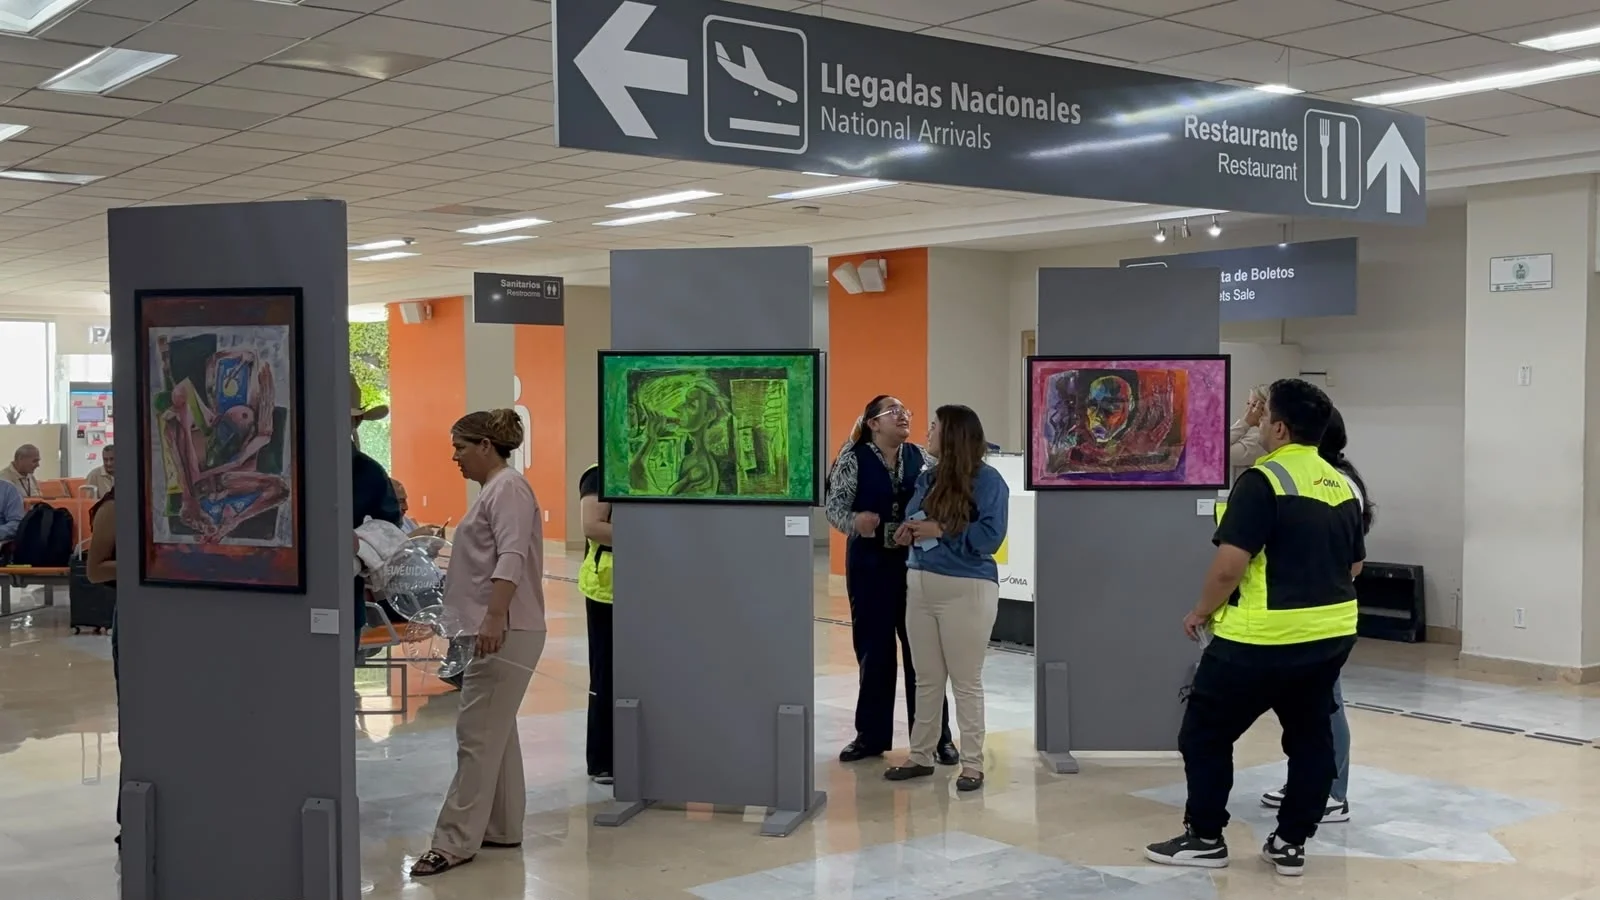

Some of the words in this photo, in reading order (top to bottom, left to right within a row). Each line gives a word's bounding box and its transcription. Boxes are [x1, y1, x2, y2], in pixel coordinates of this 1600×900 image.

[821, 62, 942, 108] Llegadas
[951, 82, 1081, 125] Nacionales
[820, 106, 911, 141] National
[918, 119, 992, 150] Arrivals
[1184, 114, 1298, 152] Restaurante
[1218, 152, 1298, 182] Restaurant
[1234, 269, 1248, 282] de
[1251, 267, 1295, 281] Boletos
[500, 279, 541, 289] Sanitarios
[506, 289, 541, 298] Restrooms
[1233, 288, 1255, 301] Sale
[1323, 479, 1341, 488] OMA
[1009, 577, 1028, 586] OMA
